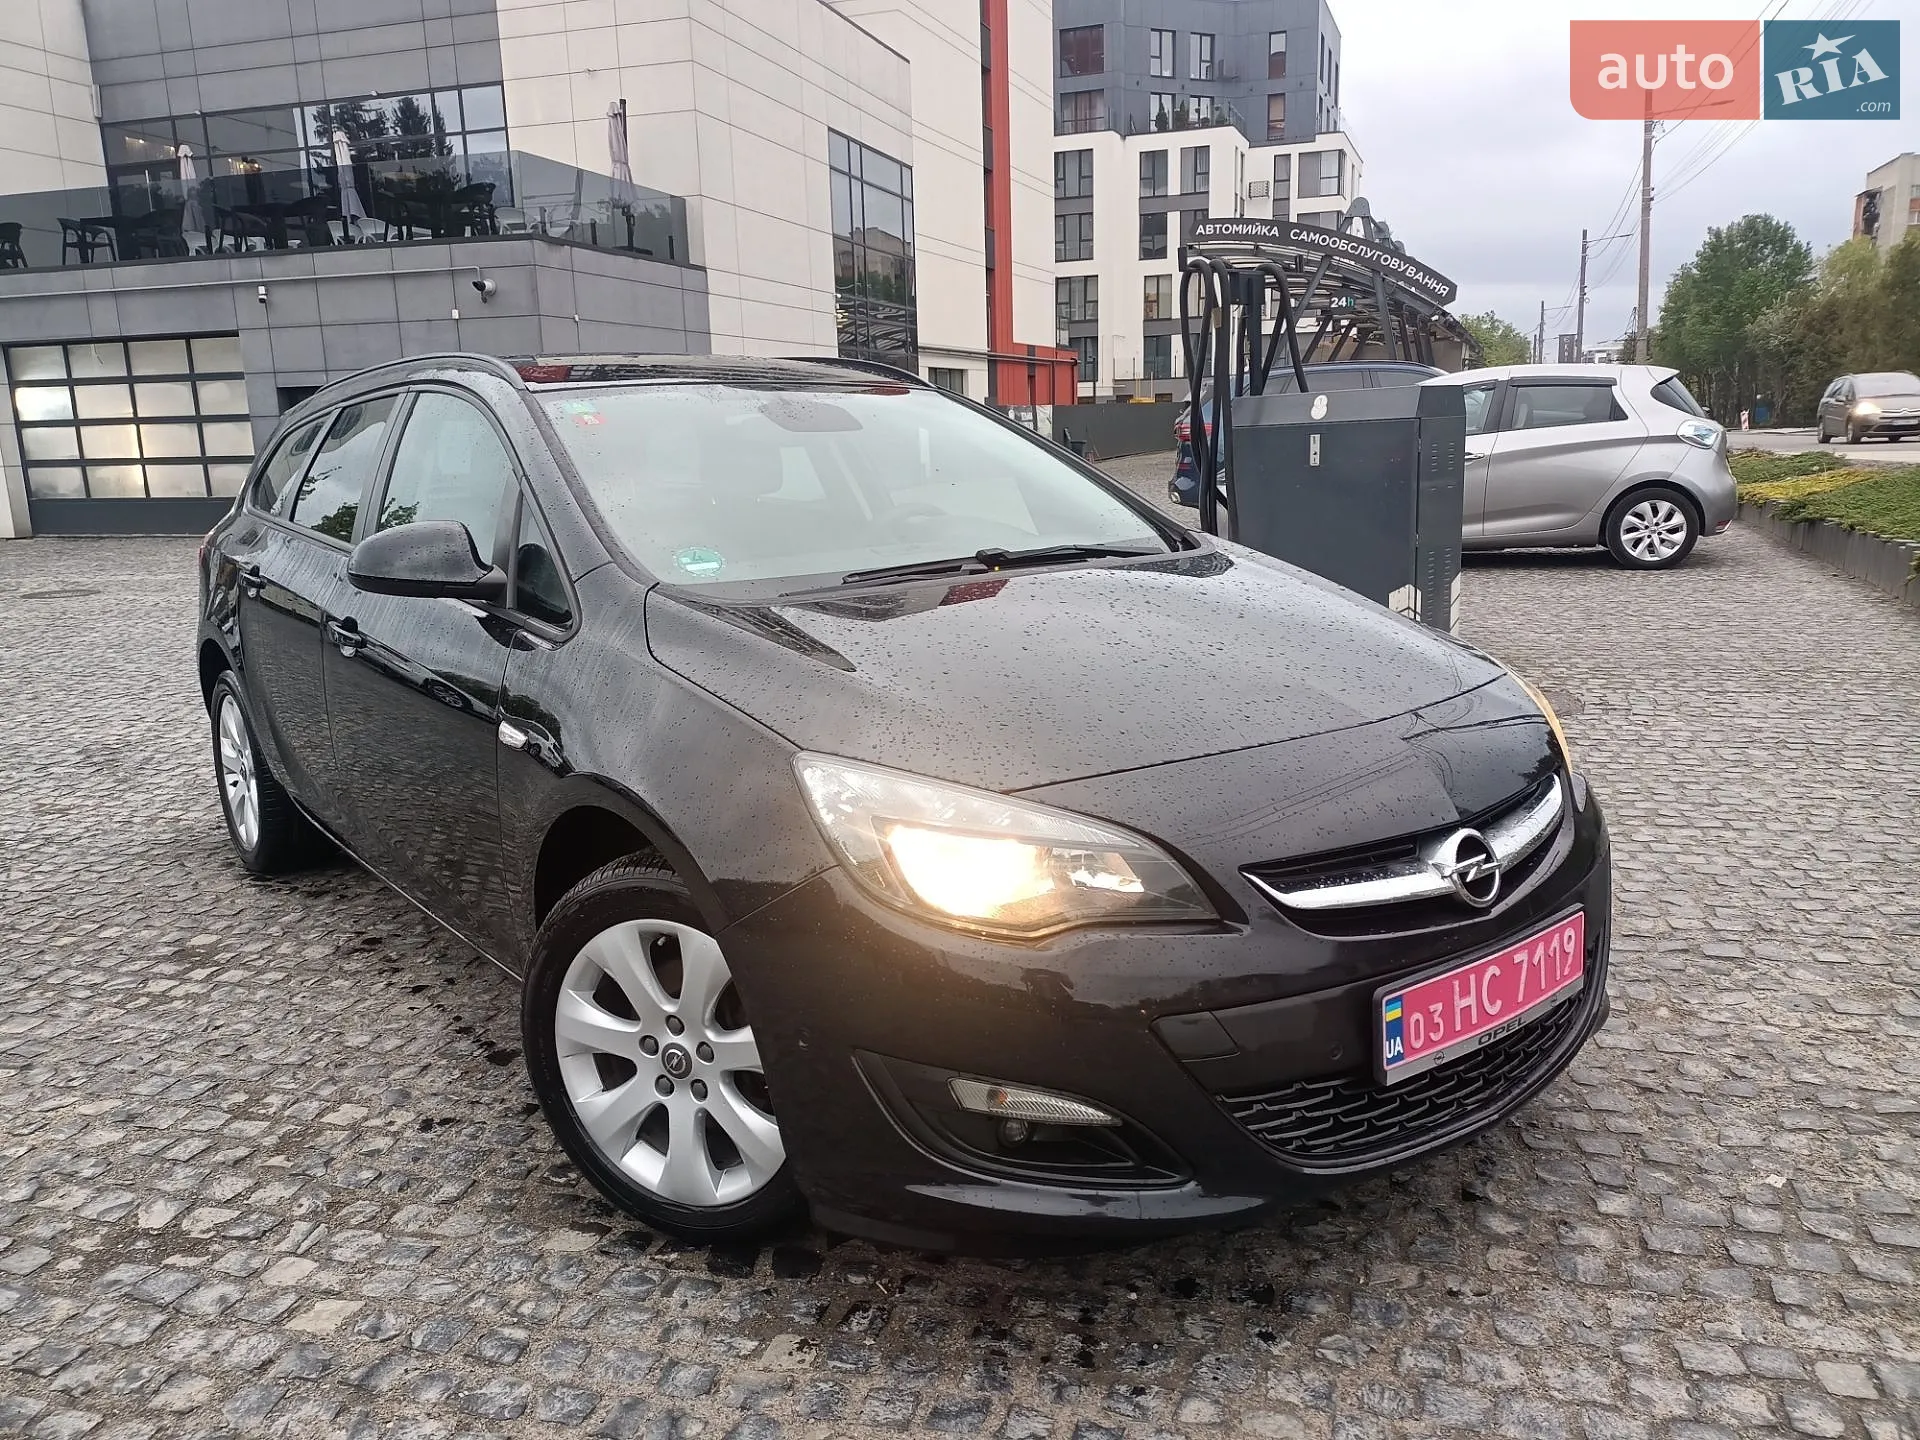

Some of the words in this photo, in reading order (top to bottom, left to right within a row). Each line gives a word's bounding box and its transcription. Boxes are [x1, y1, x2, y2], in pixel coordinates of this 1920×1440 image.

[1195, 222, 1279, 237] АВТОМИЙКА
[1290, 229, 1450, 297] САМООБСЛУГОВУВАННЯ
[1330, 296, 1354, 308] 24h
[1409, 1002, 1444, 1049] 03
[1452, 965, 1502, 1032] HC
[1513, 927, 1576, 1003] 7119
[1478, 1018, 1527, 1046] OPEL
[1385, 1037, 1404, 1058] UA
